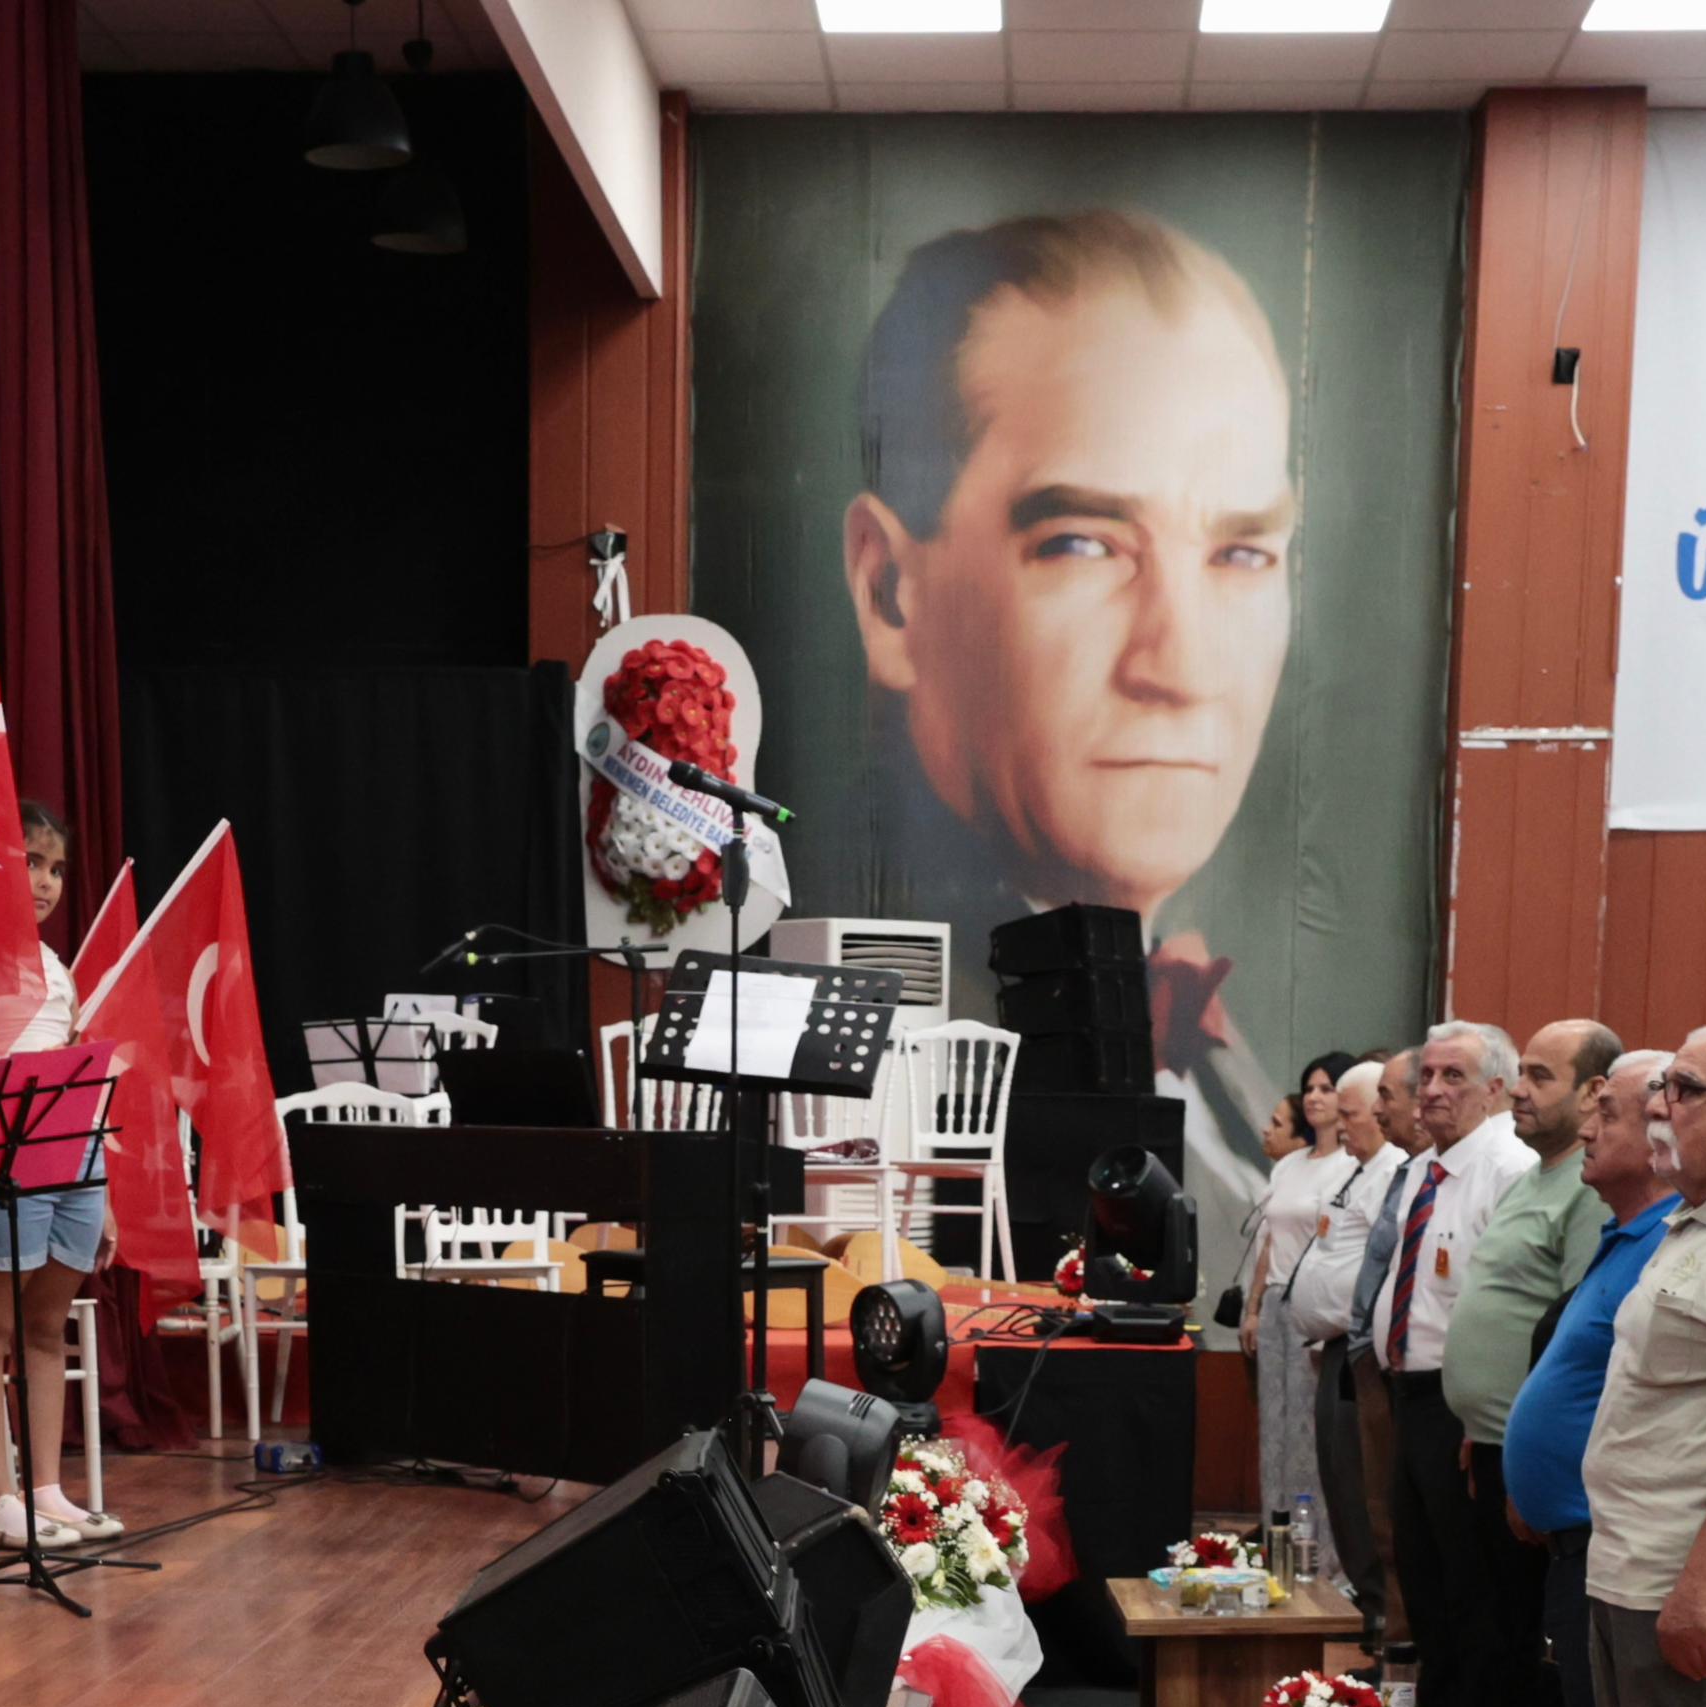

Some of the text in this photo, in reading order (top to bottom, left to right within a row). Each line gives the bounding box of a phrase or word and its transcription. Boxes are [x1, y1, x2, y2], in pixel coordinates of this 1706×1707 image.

[603, 755, 704, 834] MENEMEN BELEDİYE
[616, 744, 669, 785] AYDIN
